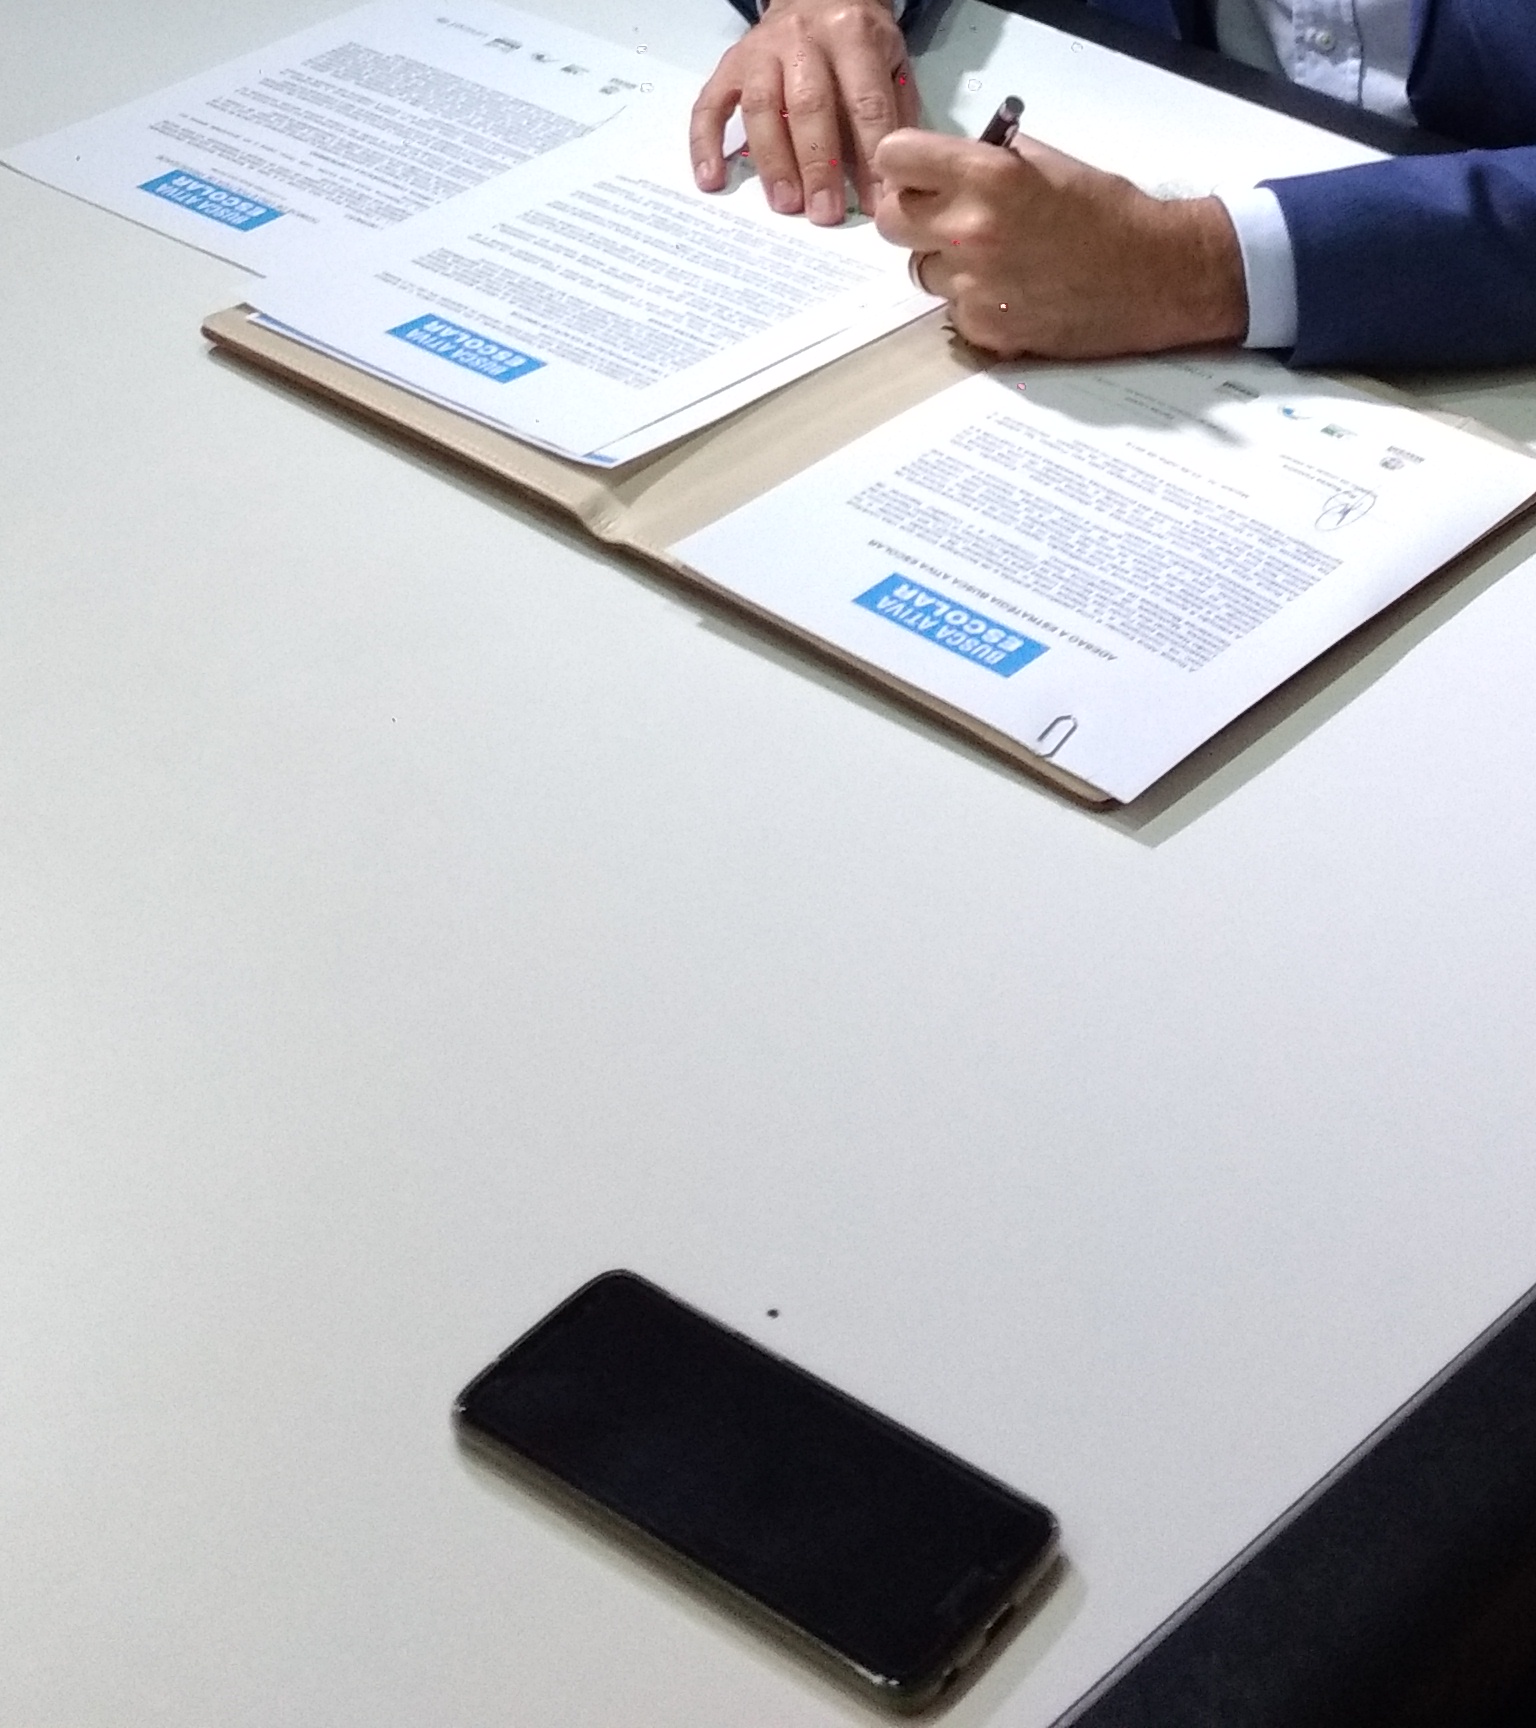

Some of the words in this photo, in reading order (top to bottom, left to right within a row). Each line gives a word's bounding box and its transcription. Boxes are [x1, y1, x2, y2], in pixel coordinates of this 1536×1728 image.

[171, 175, 268, 217] ESCOLAR
[422, 320, 527, 368] ESCOLAR
[875, 594, 939, 631] ATIVA
[892, 583, 1025, 652] ESCOLAR
[935, 624, 1007, 665] BUSCA
